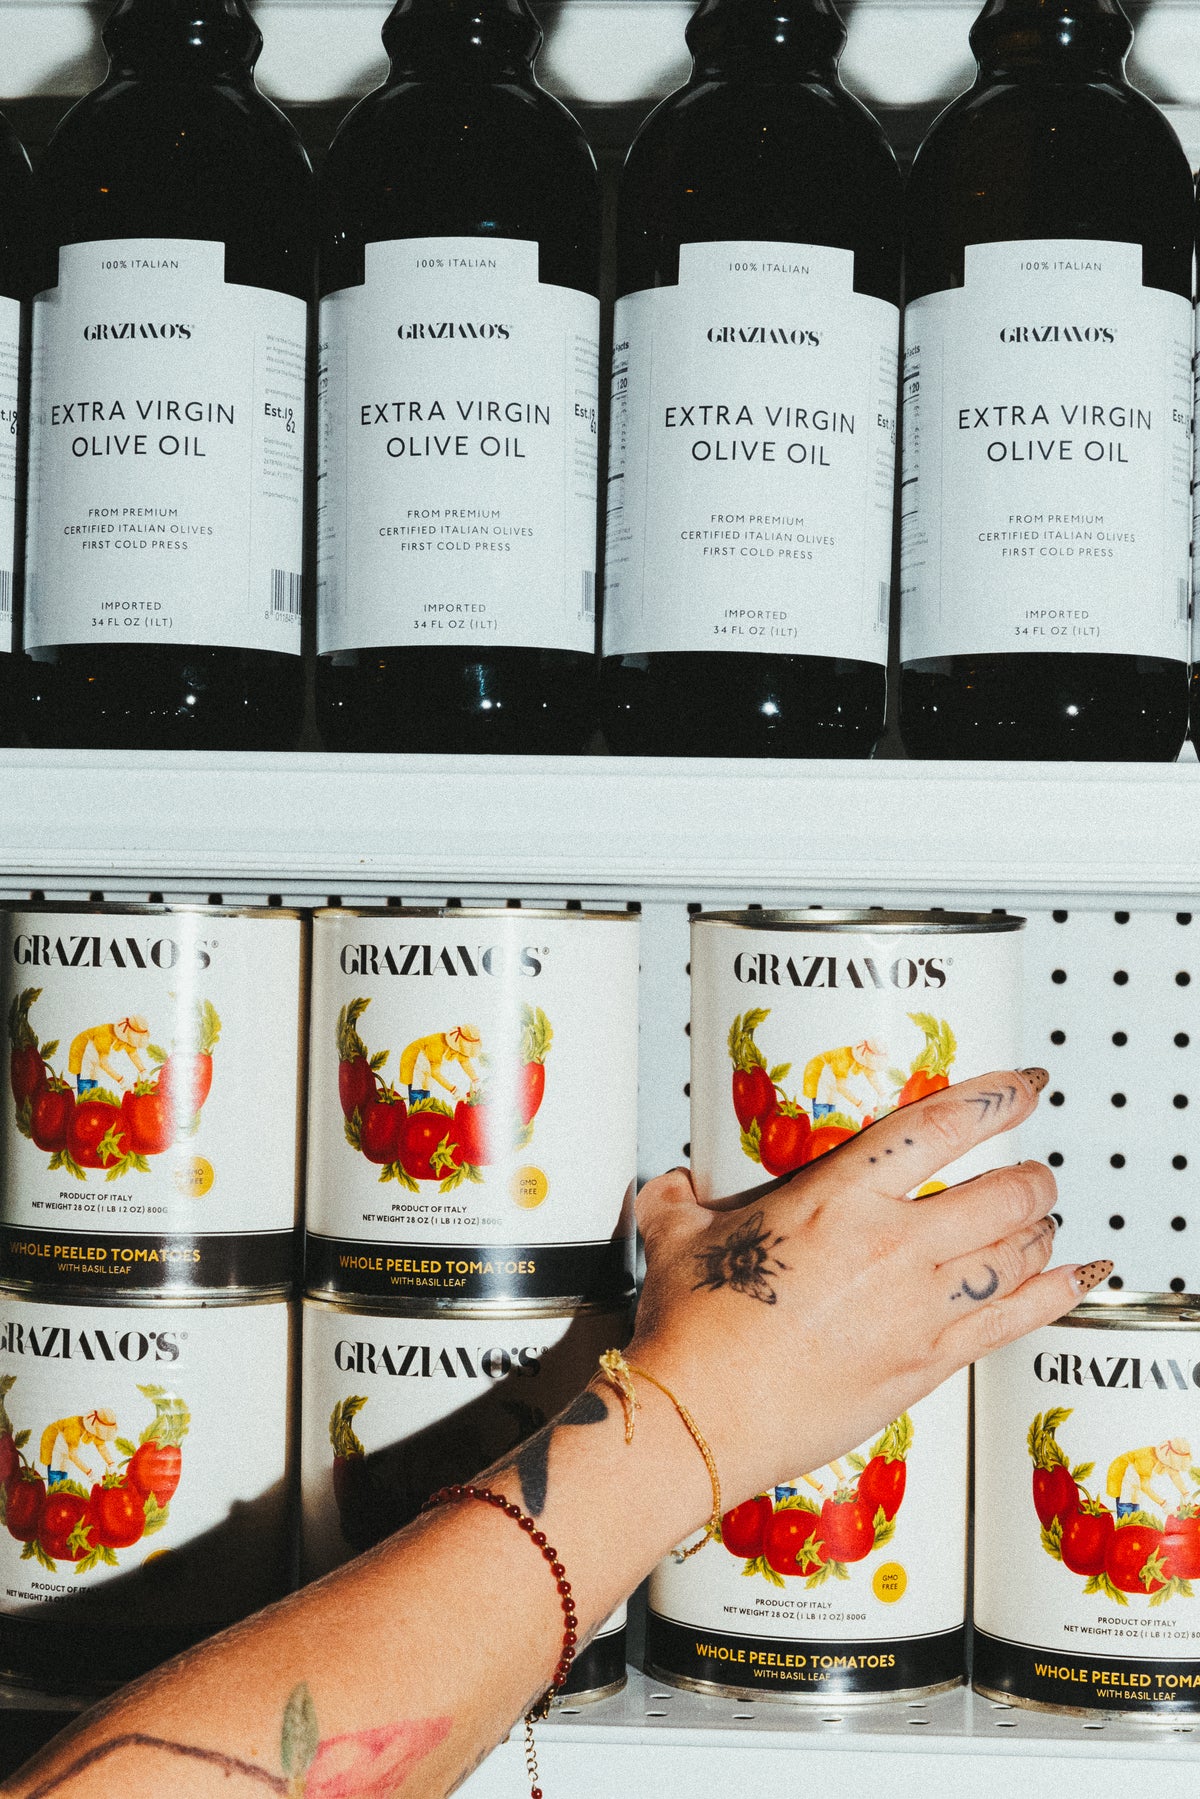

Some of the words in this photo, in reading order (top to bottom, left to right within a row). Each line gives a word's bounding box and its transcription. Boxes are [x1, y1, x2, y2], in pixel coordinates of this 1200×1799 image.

[102, 260, 127, 270] 100%
[131, 260, 178, 269] ITALIAN
[416, 259, 444, 268] 100%
[448, 259, 496, 268] ITALIAN
[729, 263, 757, 271] 100%
[762, 263, 809, 274] ITALIAN
[1021, 262, 1049, 271] 100%
[1054, 261, 1102, 271] ITALIAN
[83, 323, 191, 341] GRAZIANO'S
[397, 323, 509, 340] GRAZIANO'S
[707, 327, 819, 346] GRAZIANO'S
[1000, 326, 1114, 343] GRAZIANO'S
[51, 400, 125, 426] EXTRA
[136, 400, 234, 424] VIRGIN
[361, 401, 445, 425] EXTRA
[456, 401, 549, 425] VIRGIN
[959, 405, 1049, 429] EXTRA
[1061, 405, 1151, 430] VIRGIN
[665, 405, 753, 427] EXTRA
[765, 406, 854, 434] VIRGIN
[72, 435, 147, 457] OLIVE
[159, 435, 206, 457] OIL
[387, 436, 468, 458] OLIVE
[480, 436, 525, 458] OIL
[987, 440, 1072, 462] OLIVE
[1084, 441, 1128, 463] OIL
[692, 440, 775, 461] OLIVE
[787, 443, 830, 466] OIL
[89, 508, 118, 517] FROM
[122, 508, 177, 517] PREMIUM
[407, 509, 440, 518] FROM
[445, 509, 500, 518] PREMIUM
[711, 514, 745, 523] FROM
[749, 515, 804, 526] PREMIUM
[1009, 515, 1043, 524] FROM
[1048, 515, 1103, 524] PREMIUM
[63, 524, 114, 535] CERTIFIED
[118, 524, 165, 533] ITALIAN
[170, 524, 213, 535] OLIVES
[379, 526, 436, 537] CERTIFIED
[441, 525, 488, 534] ITALIAN
[493, 526, 533, 537] OLIVES
[680, 531, 740, 540] CERTIFIED
[745, 531, 792, 542] ITALIAN
[796, 534, 835, 546] OLIVES
[978, 531, 1039, 542] CERTIFIED
[1044, 531, 1092, 540] ITALIAN
[1096, 531, 1135, 543] OLIVES
[82, 540, 110, 550] FIRST
[114, 540, 147, 549] COLD
[152, 540, 188, 550] PRESS
[401, 542, 432, 551] FIRST
[437, 541, 471, 551] COLD
[475, 542, 510, 551] PRESS
[703, 547, 735, 556] FIRST
[740, 547, 774, 557] COLD
[779, 549, 813, 560] PRESS
[1002, 547, 1035, 557] FIRST
[1039, 547, 1074, 556] COLD
[1079, 547, 1113, 557] PRESS
[101, 601, 161, 610] IMPORTED
[424, 604, 486, 613] IMPORTED
[724, 609, 787, 620] IMPORTED
[1026, 610, 1089, 619] IMPORTED
[92, 618, 104, 627] 34
[108, 617, 119, 626] FL
[124, 617, 140, 626] OZ
[414, 620, 427, 629] 34
[431, 620, 443, 629] FL
[448, 620, 465, 629] OZ
[714, 625, 727, 634] 34
[731, 626, 744, 634] FL
[749, 626, 765, 635] OZ
[1015, 627, 1028, 635] 34
[1033, 626, 1045, 635] FL
[1050, 626, 1067, 635] OZ
[13, 934, 211, 969] GRAZIANOS
[734, 952, 946, 988] GRAZIANO'S
[59, 1192, 96, 1200] PRODUCT
[45, 1202, 72, 1210] WEIGHT
[391, 1204, 429, 1212] PRODUCT
[376, 1215, 405, 1223] WEIGHT
[406, 1216, 415, 1224] 28
[9, 1241, 52, 1258] WHOLE
[54, 1246, 107, 1260] PEELED
[57, 1263, 81, 1272] WITH
[82, 1265, 107, 1273] BASIL
[109, 1265, 132, 1274] LEAF
[340, 1256, 383, 1271] WHOLE
[387, 1259, 441, 1273] PEELED
[390, 1277, 414, 1285] WITH
[415, 1278, 442, 1287] BASIL
[443, 1278, 467, 1287] LEAF
[882, 1574, 898, 1582] GMO
[755, 1598, 794, 1607] PRODUCT
[739, 1608, 769, 1616] WEIGHT
[829, 1613, 844, 1622] OZ)
[1098, 1617, 1138, 1626] PRODUCT
[1080, 1626, 1112, 1635] WEIGHT
[1114, 1629, 1124, 1637] 28
[696, 1643, 746, 1663] WHOLE
[750, 1651, 806, 1667] PEELED
[810, 1654, 895, 1668] TOMATOES
[753, 1668, 778, 1679] WITH
[780, 1671, 806, 1681] BASIL
[808, 1672, 831, 1681] LEAF
[1035, 1663, 1088, 1682] WHOLE
[1092, 1671, 1151, 1687] PEELED
[1096, 1689, 1122, 1699] WITH
[1124, 1691, 1151, 1700] BASIL
[1153, 1692, 1176, 1701] LEAF
